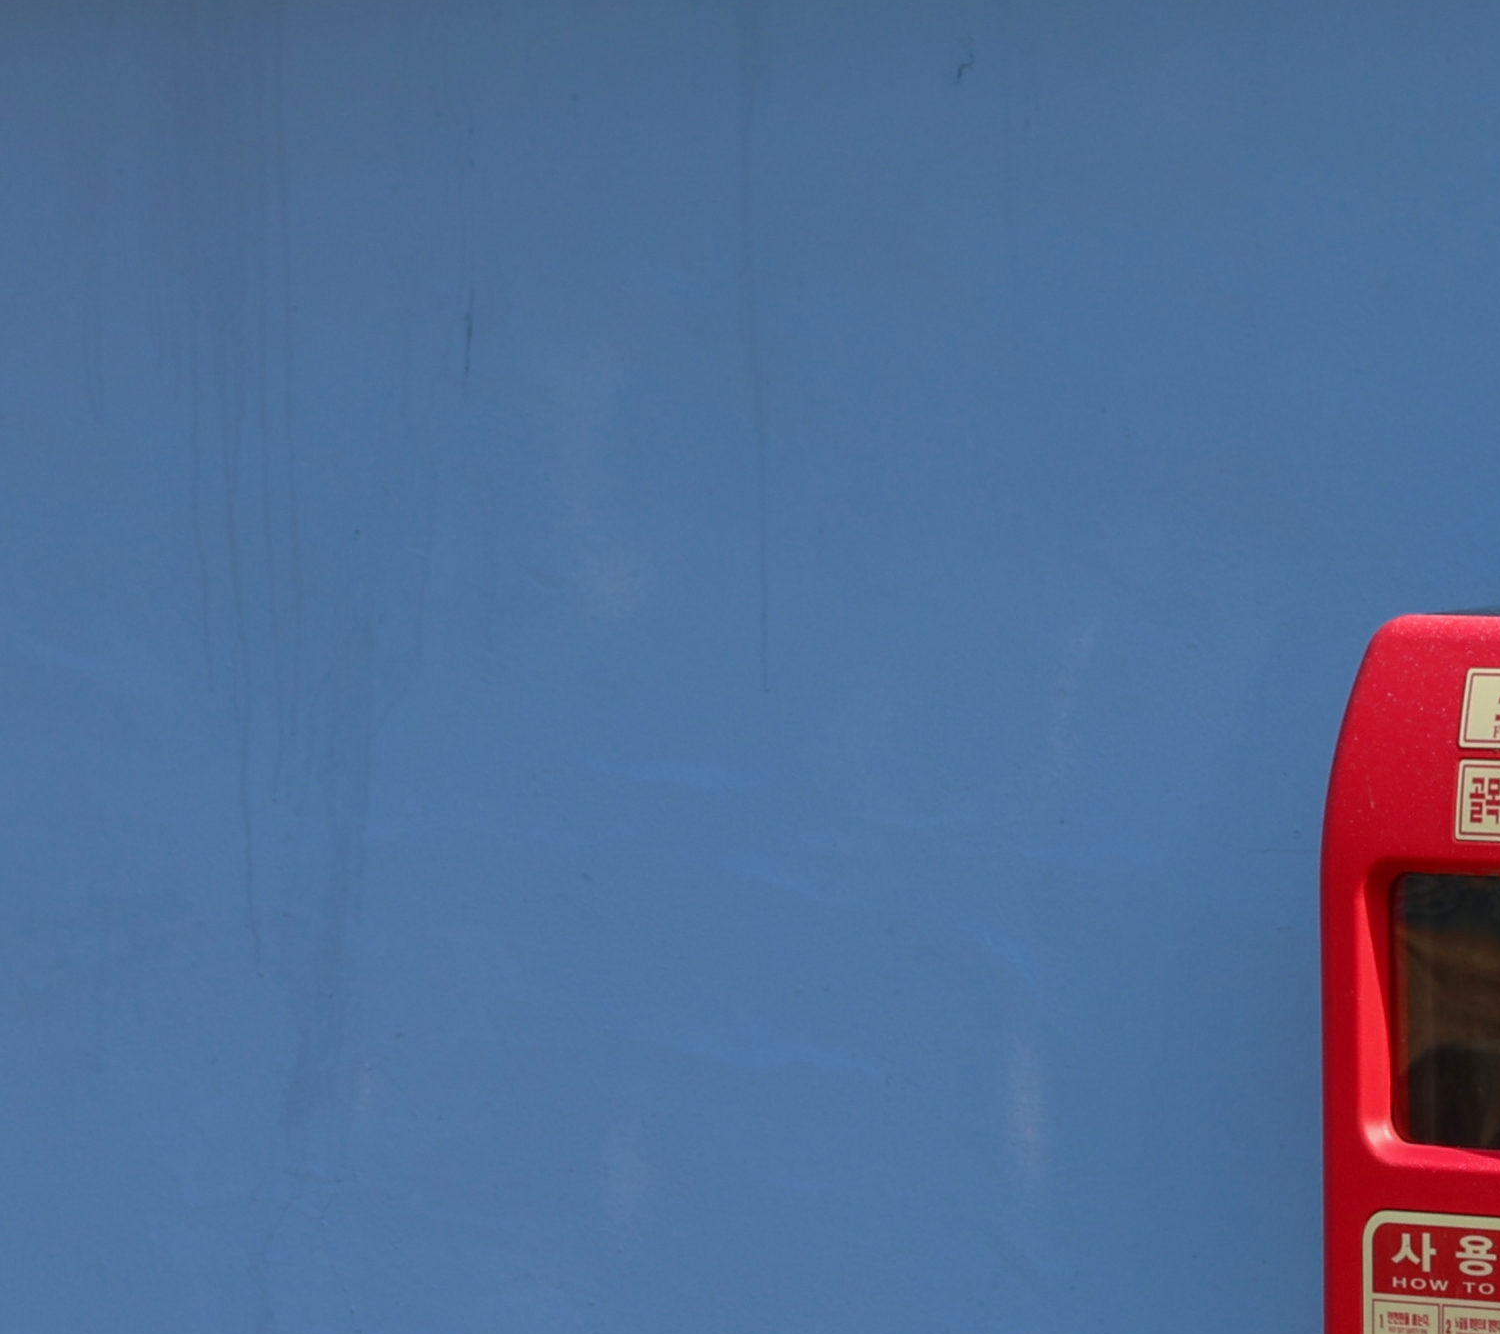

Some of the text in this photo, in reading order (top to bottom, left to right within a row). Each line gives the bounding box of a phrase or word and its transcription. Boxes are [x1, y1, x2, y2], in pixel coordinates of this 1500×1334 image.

[1392, 1276, 1449, 1291] HOW
[1462, 1281, 1495, 1295] TO
[1445, 1319, 1452, 1334] 2
